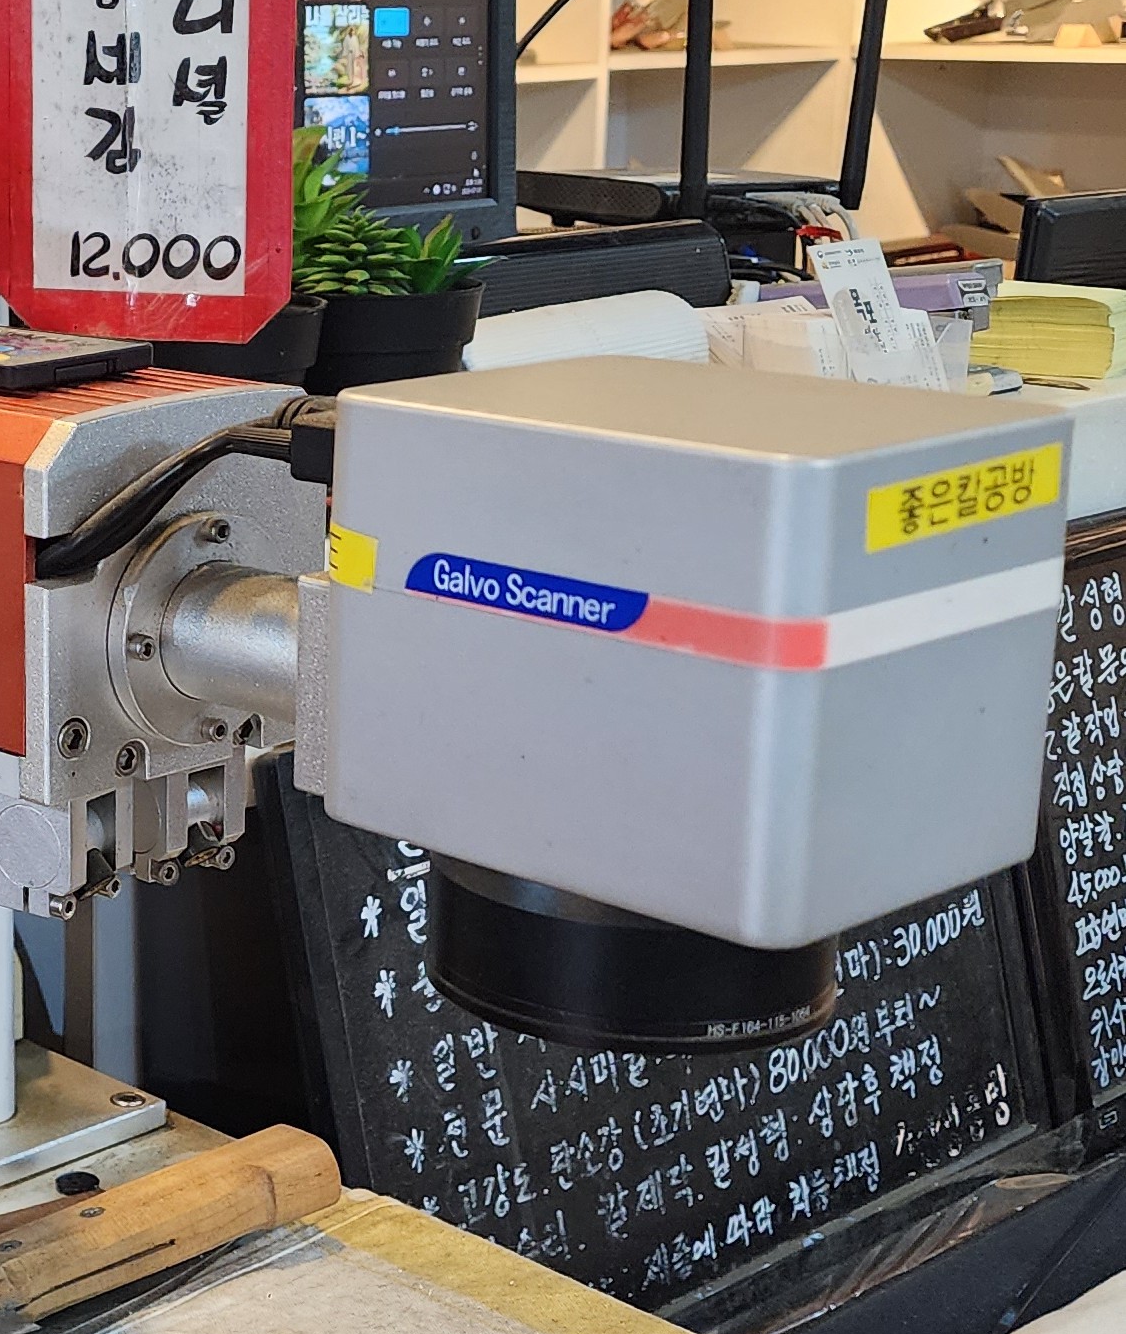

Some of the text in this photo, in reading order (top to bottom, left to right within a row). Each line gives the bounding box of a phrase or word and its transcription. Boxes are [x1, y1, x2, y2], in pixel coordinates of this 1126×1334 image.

[70, 229, 242, 281] 12.000
[898, 458, 1035, 535] 좋은칼공방
[433, 558, 616, 624] Galvo Scanner
[890, 1033, 944, 1099] 책정
